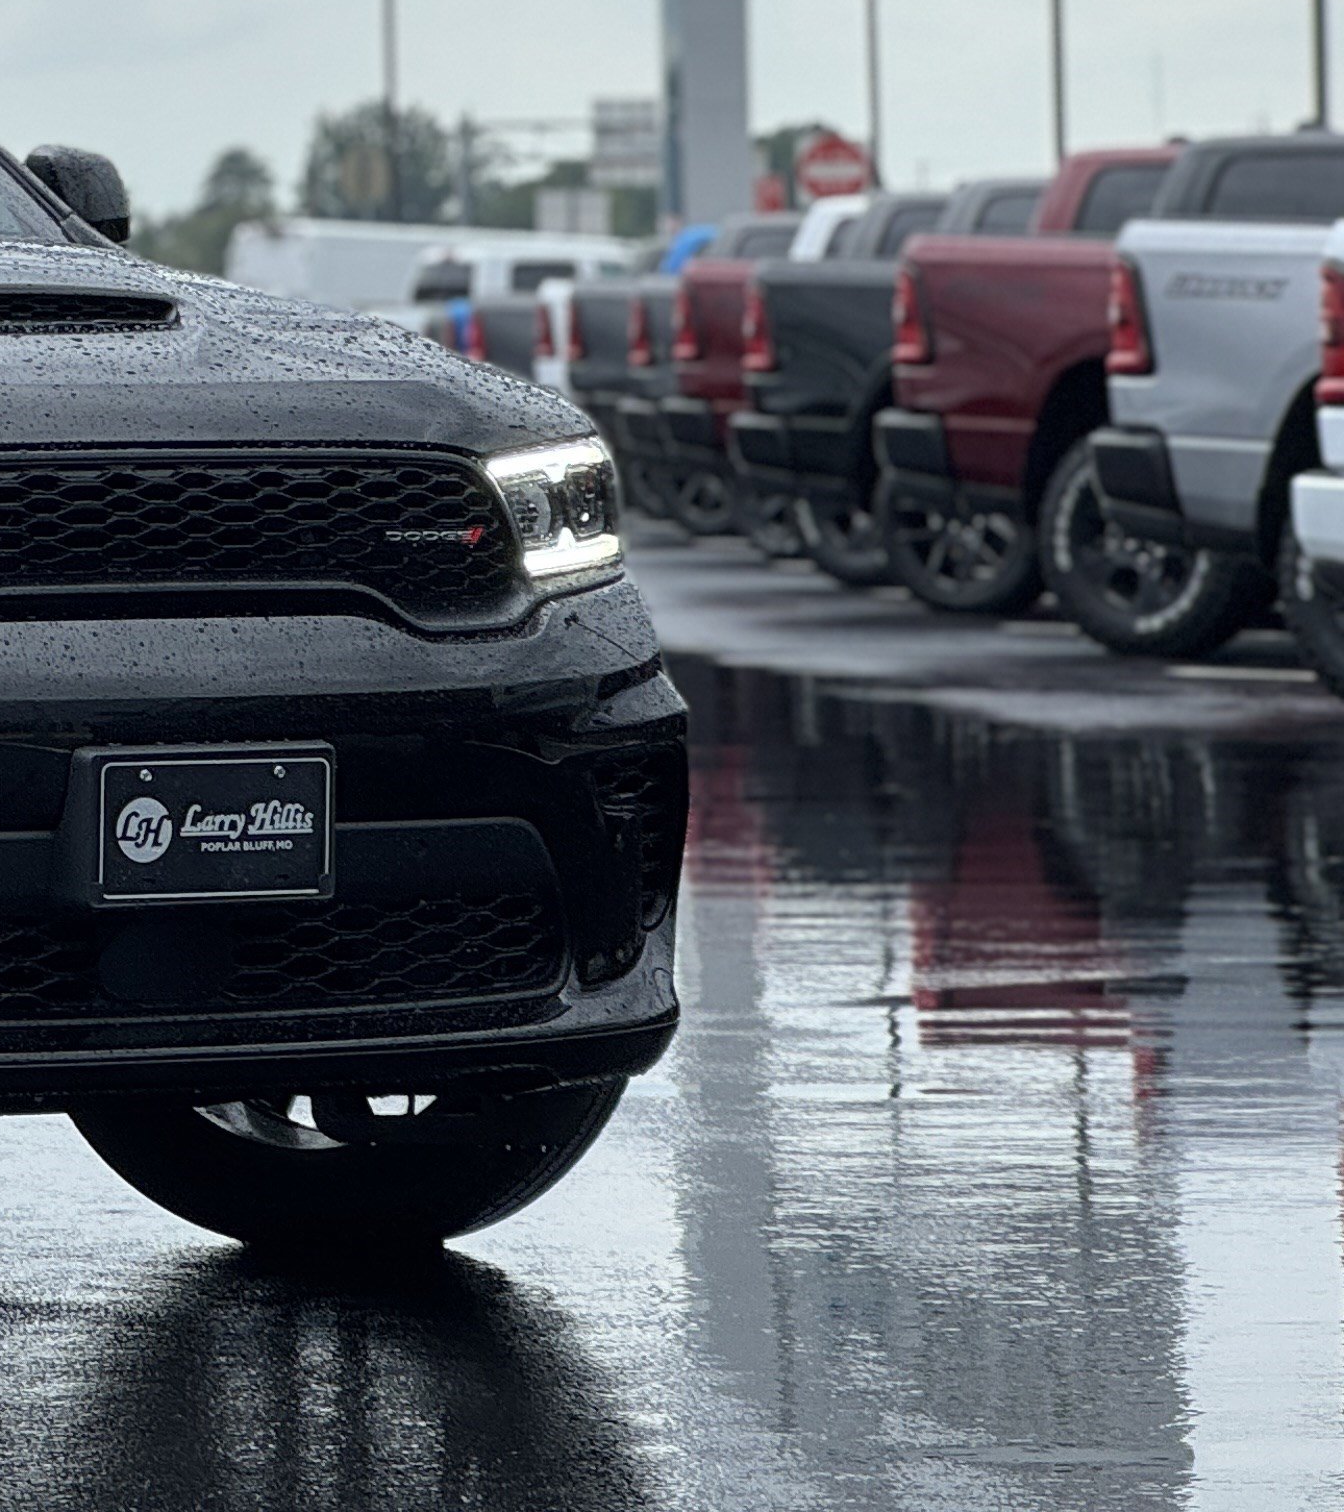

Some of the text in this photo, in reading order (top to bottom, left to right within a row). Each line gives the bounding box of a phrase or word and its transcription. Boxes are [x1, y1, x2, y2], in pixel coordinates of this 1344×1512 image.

[180, 799, 314, 840] Larry Hillis
[200, 841, 242, 853] POPLAR
[276, 839, 294, 851] MO
